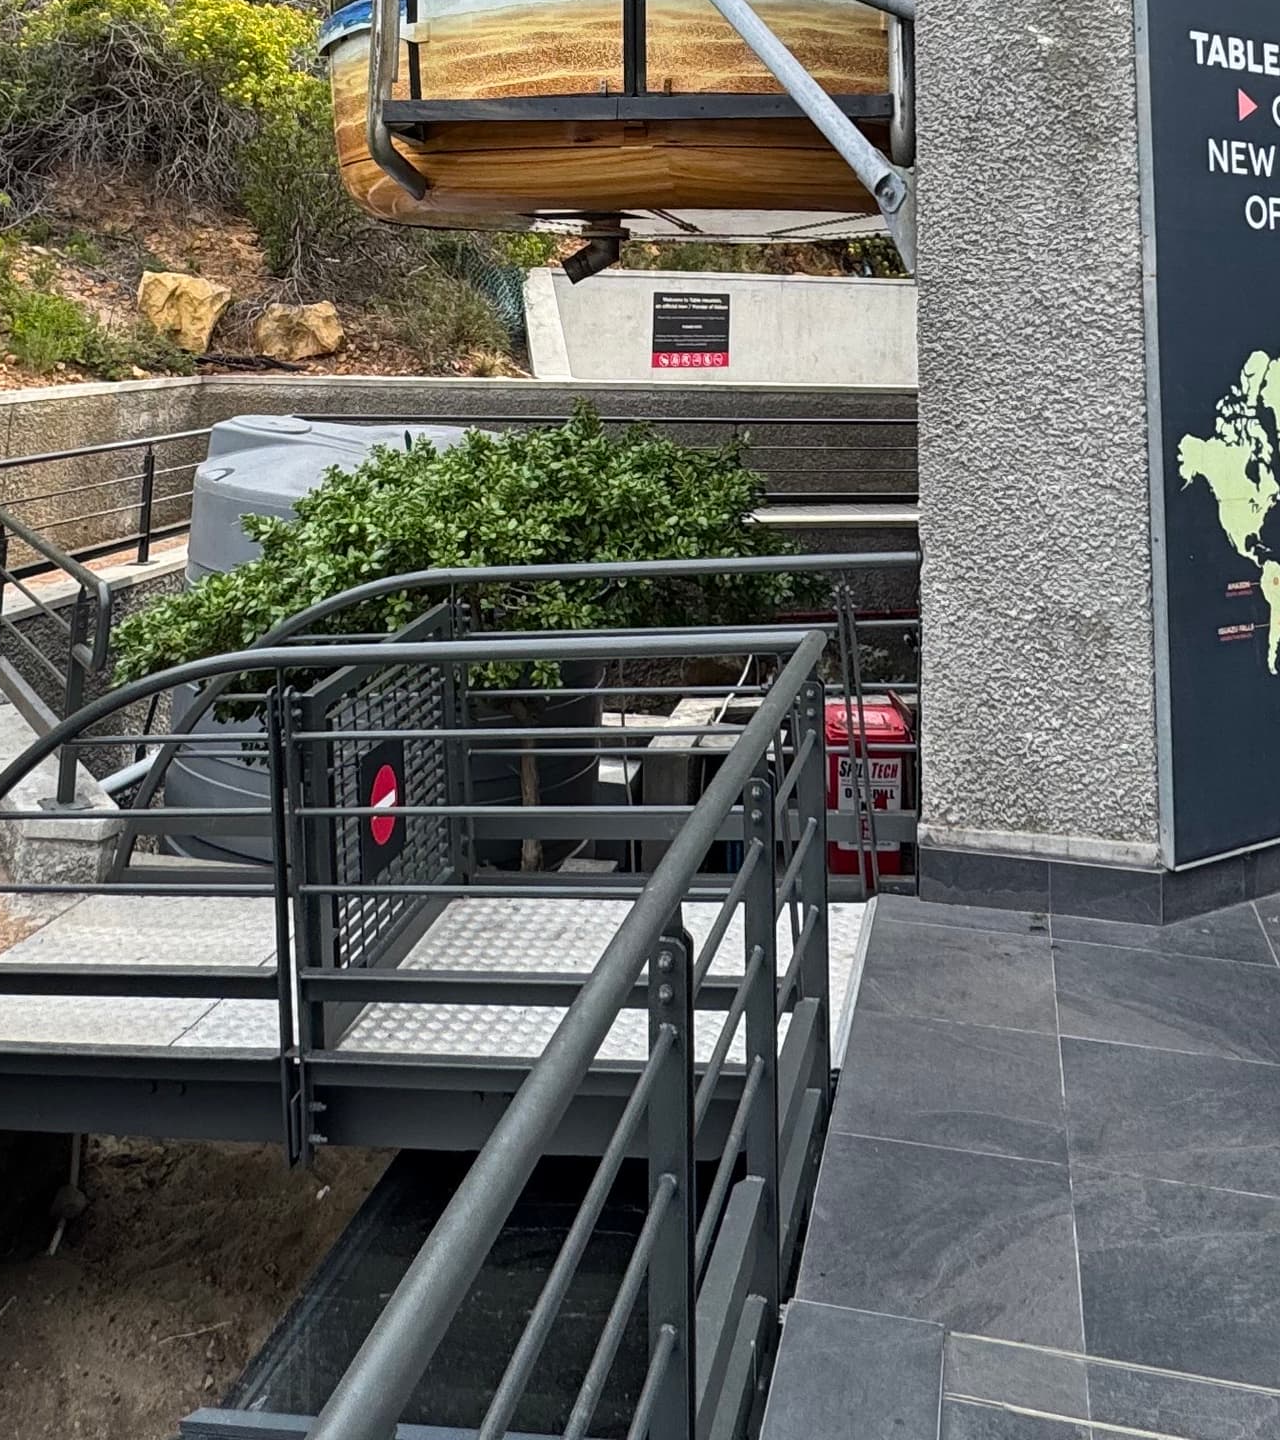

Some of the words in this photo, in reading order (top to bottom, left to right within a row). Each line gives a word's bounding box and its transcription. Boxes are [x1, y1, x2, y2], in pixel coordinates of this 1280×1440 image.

[1189, 30, 1280, 76] TABLE
[1207, 137, 1276, 178] NEW
[871, 762, 899, 779] TECH
